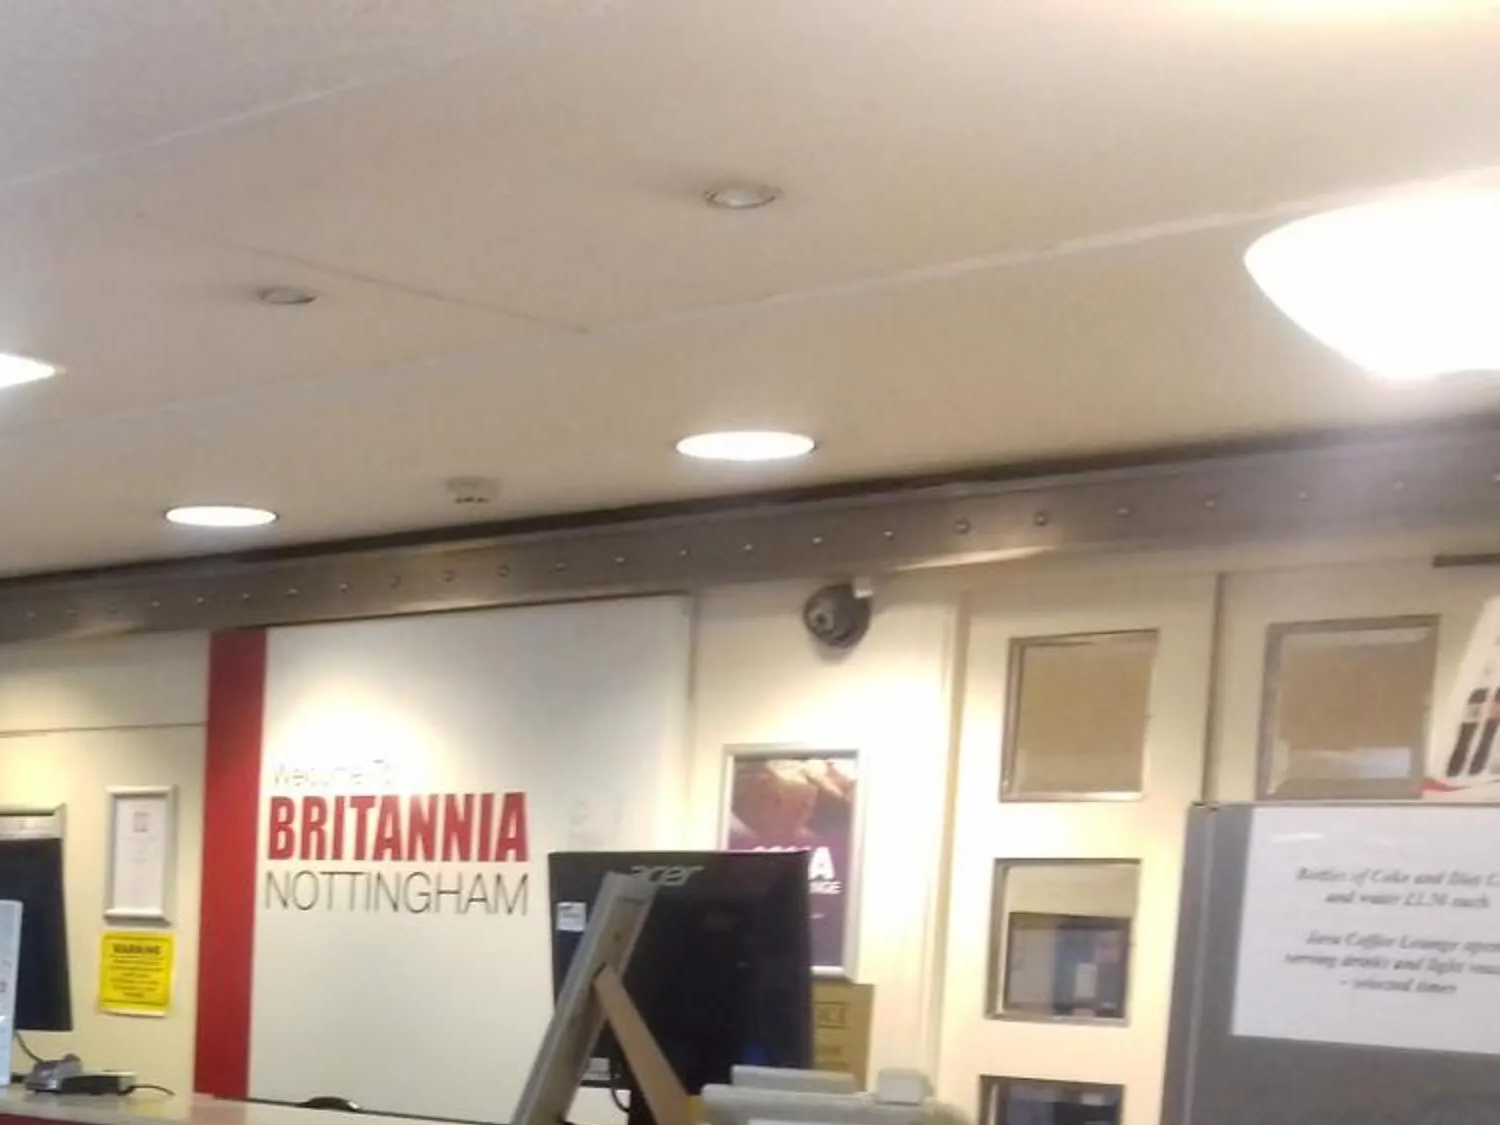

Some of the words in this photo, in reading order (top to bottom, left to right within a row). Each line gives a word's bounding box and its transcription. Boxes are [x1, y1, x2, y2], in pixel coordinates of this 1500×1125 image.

[268, 791, 529, 862] BRITANNIA
[264, 869, 529, 917] NOTTINGHAM
[631, 864, 706, 887] acer
